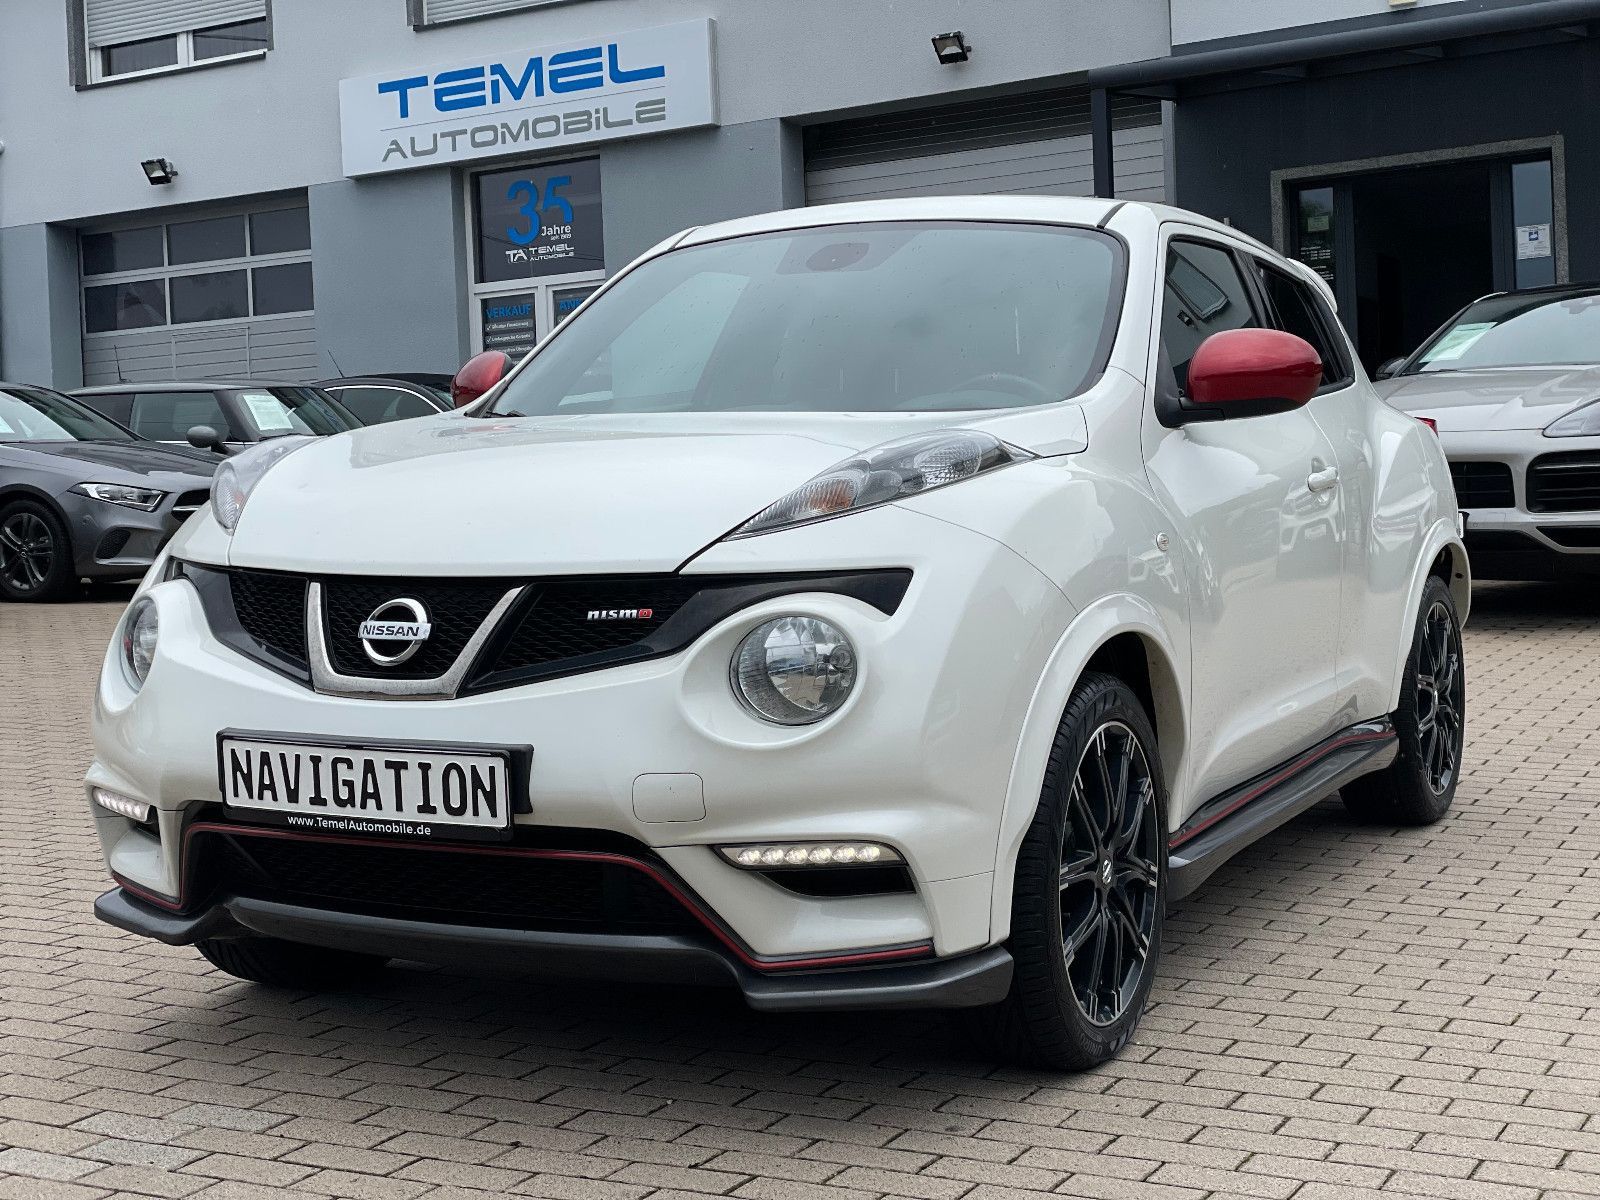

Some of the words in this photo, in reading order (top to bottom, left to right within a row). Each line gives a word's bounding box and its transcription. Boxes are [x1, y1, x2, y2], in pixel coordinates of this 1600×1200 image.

[377, 43, 666, 119] TEMEL
[506, 175, 574, 246] 35
[541, 225, 572, 237] Jahre
[505, 249, 528, 263] TA
[528, 243, 575, 255] TEMEL
[486, 303, 532, 319] VERKAUF
[362, 624, 419, 638] NISSAN
[230, 748, 498, 818] NAVIGATION
[287, 814, 431, 836] www.TemelAutomobile.de
